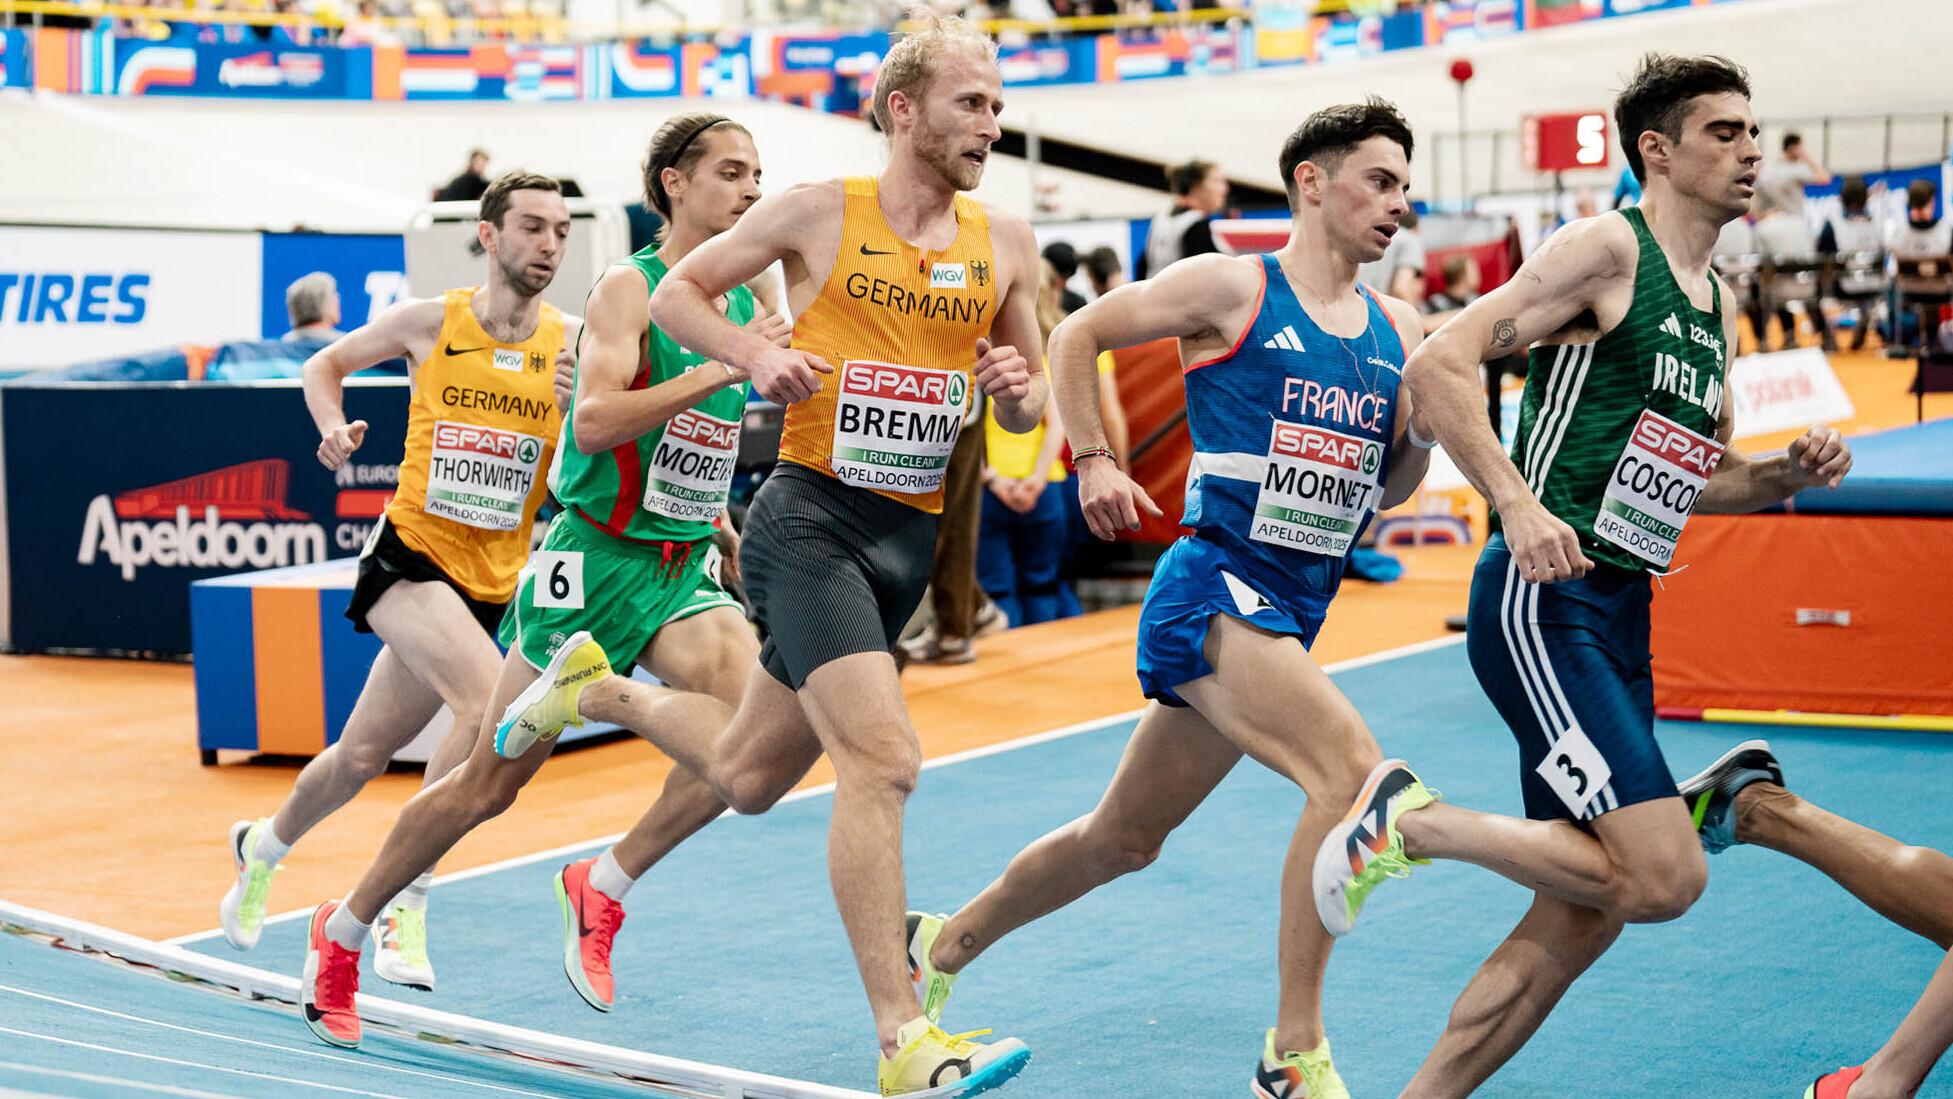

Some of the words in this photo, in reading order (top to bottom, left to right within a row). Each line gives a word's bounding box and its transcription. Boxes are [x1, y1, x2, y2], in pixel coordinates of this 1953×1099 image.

[1576, 115, 1605, 164] 5
[932, 269, 965, 282] WGV
[0, 274, 150, 324] TIRES
[846, 272, 988, 325] GERMANY
[494, 353, 522, 366] WGV
[847, 367, 946, 400] SPAR
[442, 386, 553, 421] GERMANY
[1282, 377, 1388, 434] FRANCE
[839, 403, 961, 443] BREMM
[438, 427, 517, 455] SPAR
[1276, 428, 1362, 467] SPAR
[433, 457, 532, 494] THORWIRTH
[837, 466, 925, 487] APELDOORN
[863, 451, 867, 461] I
[869, 452, 898, 465] RUN
[900, 455, 936, 468] CLEAN
[457, 493, 479, 506] RUN
[670, 486, 693, 499] RUN
[1264, 462, 1372, 511] MORNET
[430, 501, 499, 526] APELDOORN
[1285, 510, 1290, 519] I
[1292, 512, 1318, 526] RUN
[1625, 508, 1632, 518] I
[1631, 511, 1659, 532] RUN
[1658, 525, 1680, 540] CLE
[78, 494, 327, 580] Apeldoorn
[549, 560, 570, 600] 6
[1556, 754, 1588, 797] 3
